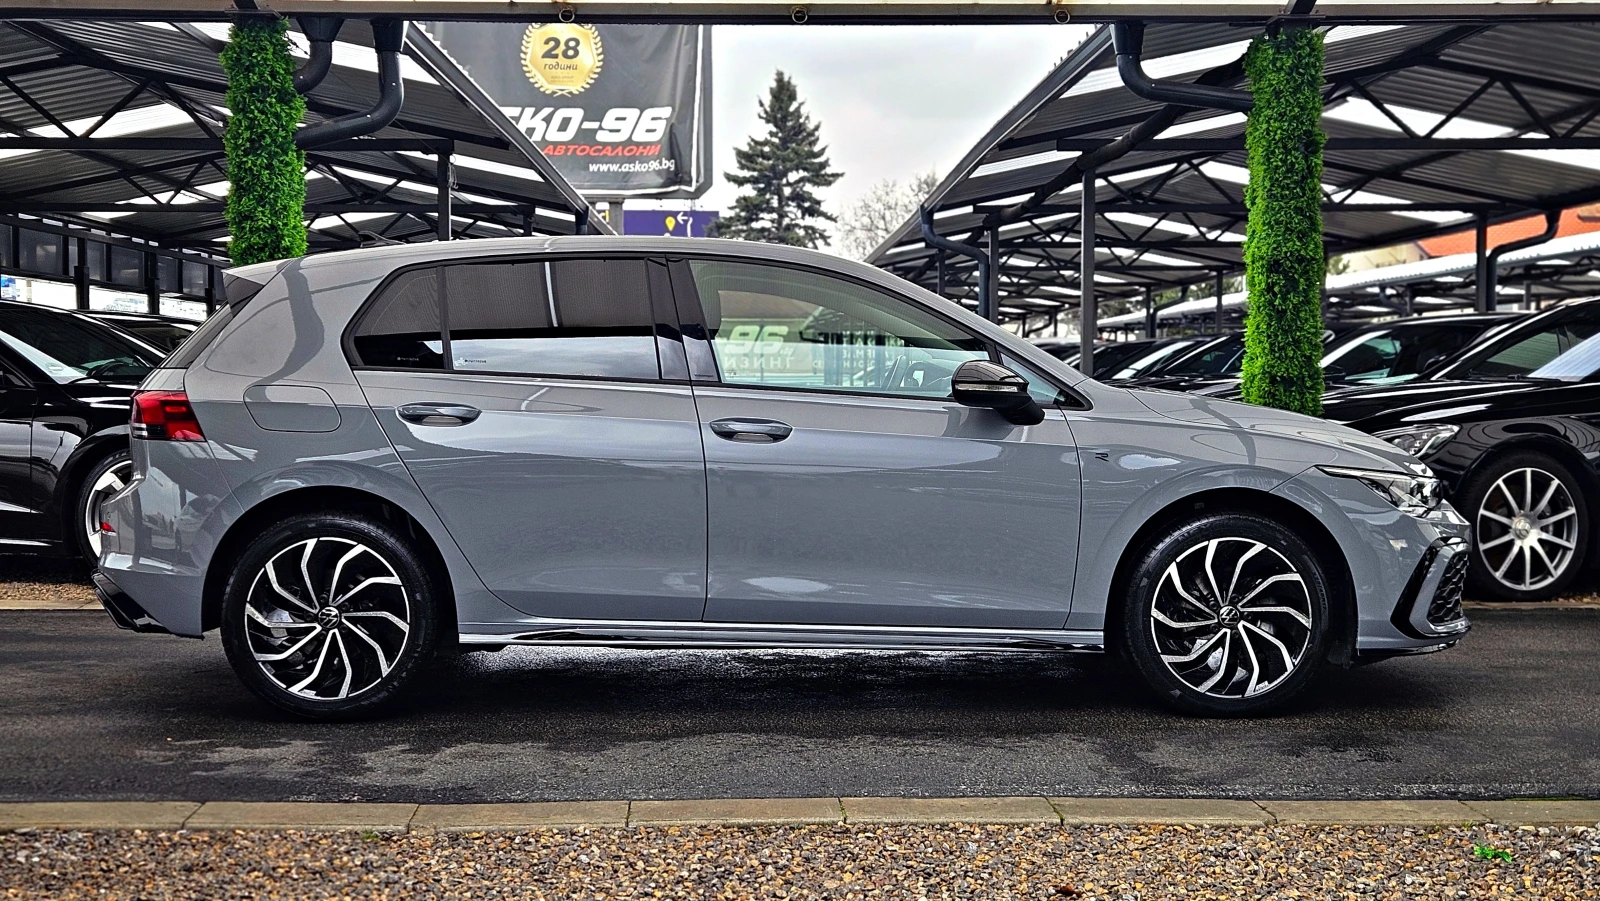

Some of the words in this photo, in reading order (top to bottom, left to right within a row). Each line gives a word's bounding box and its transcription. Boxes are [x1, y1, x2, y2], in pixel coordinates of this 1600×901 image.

[541, 36, 580, 59] 28
[543, 61, 578, 71] години
[543, 144, 662, 157] АВТОСАЛОНИ
[588, 157, 676, 172] www.asko96.bg
[723, 356, 795, 369] ИЗИНГ
